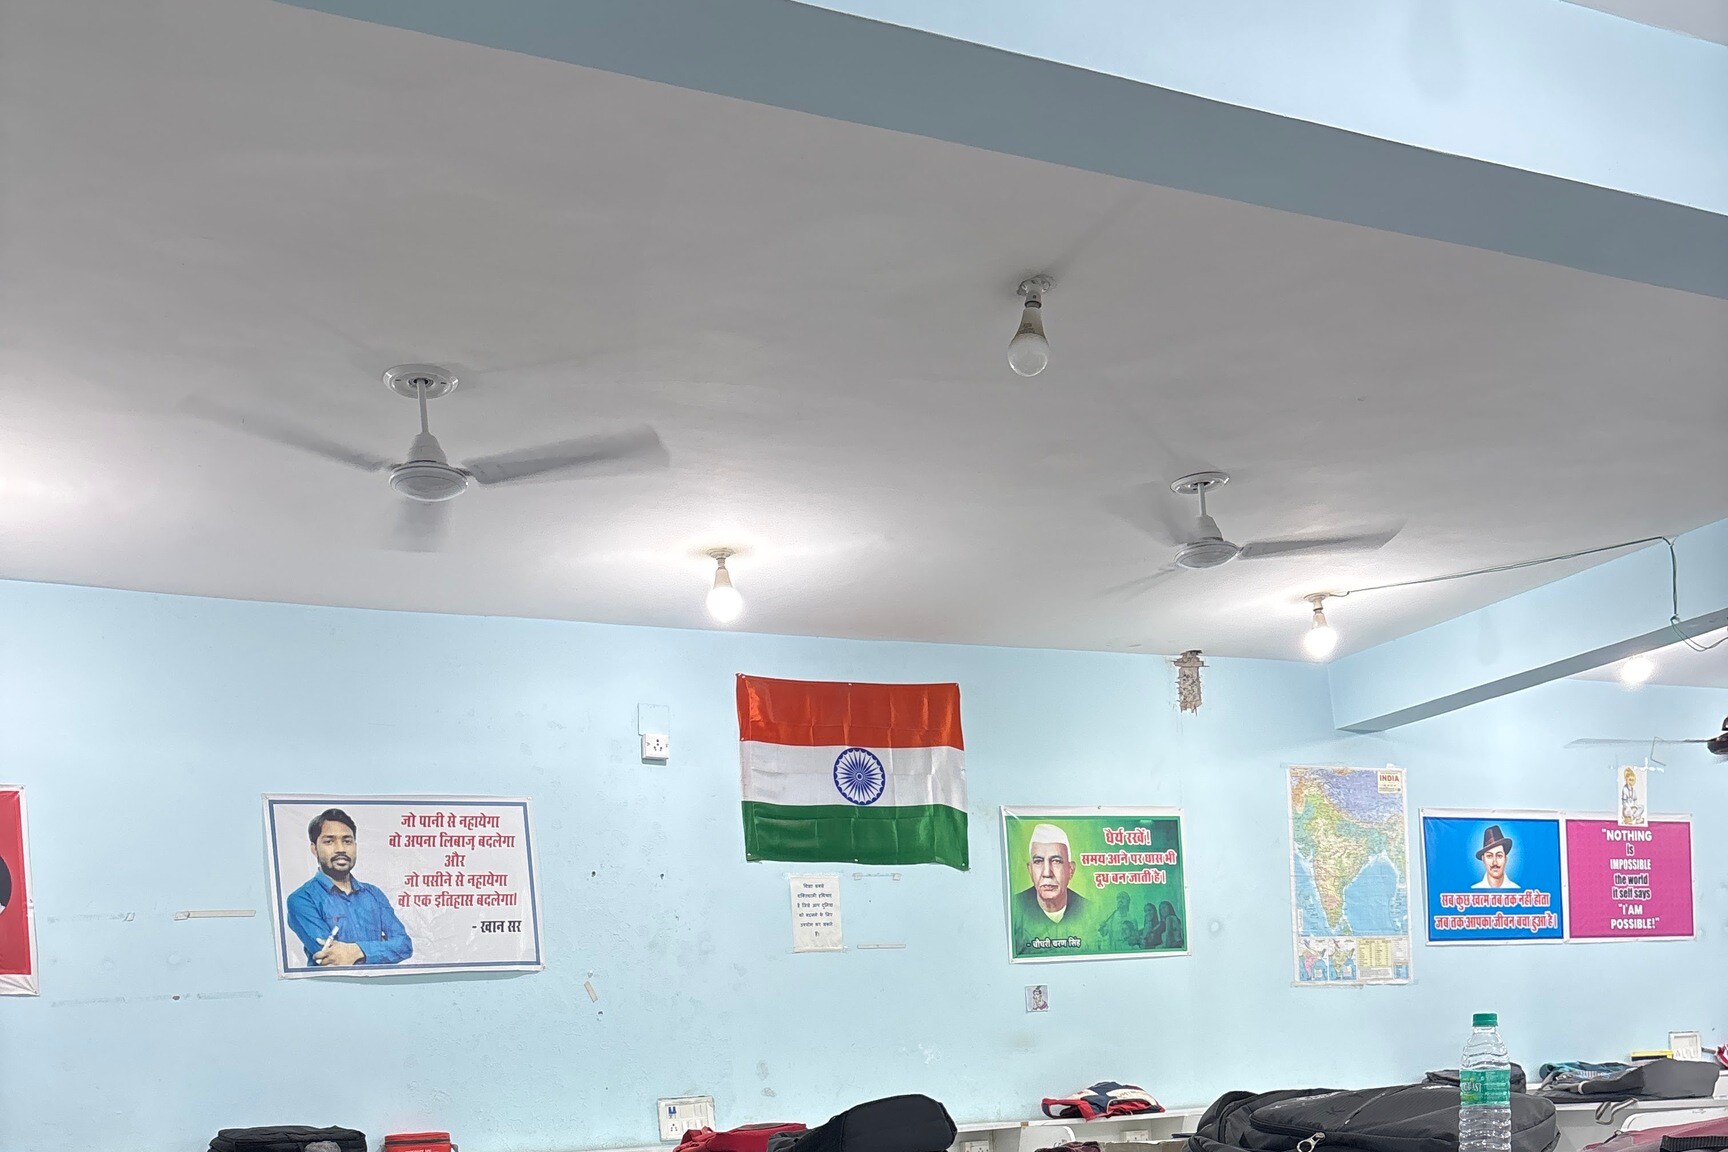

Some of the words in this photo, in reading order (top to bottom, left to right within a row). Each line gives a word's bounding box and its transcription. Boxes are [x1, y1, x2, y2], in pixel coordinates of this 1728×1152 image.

[401, 812, 416, 828] जो
[419, 812, 444, 828] पानी
[447, 812, 457, 828] से
[459, 813, 500, 830] नहायेगा
[404, 834, 437, 848] अपना
[439, 832, 476, 850] लिबाज़
[478, 833, 516, 848] बदलेगा
[1104, 828, 1123, 844] धैर्य
[444, 851, 466, 867] और
[1081, 853, 1106, 865] समय
[1108, 851, 1128, 865] आने
[1130, 853, 1143, 864] पर
[1144, 853, 1164, 864] घास
[1165, 850, 1176, 864] भी
[1610, 859, 1652, 870] IMPOSSIBLE
[404, 872, 420, 887] जो
[422, 871, 453, 887] पसीने
[455, 872, 466, 887] से
[467, 871, 508, 889] नहायेगा
[1095, 873, 1109, 887] दूध
[1112, 873, 1125, 883] बन
[1129, 870, 1152, 883] जाती
[1614, 874, 1627, 885] the
[1628, 874, 1648, 885] world
[398, 892, 411, 907] वो
[413, 894, 433, 907] एक
[435, 891, 475, 909] इतिहास
[1442, 894, 1454, 906] सब
[1456, 894, 1470, 910] कुछ
[1471, 894, 1489, 906] खत्म
[1491, 894, 1502, 905] तब
[1504, 894, 1517, 905] तक
[1518, 891, 1532, 905] नहीं
[1534, 891, 1549, 906] होता
[1612, 888, 1618, 898] it
[1619, 888, 1633, 899] self
[1634, 889, 1651, 899] says
[480, 920, 505, 933] खान
[508, 920, 522, 933] सर
[1435, 917, 1449, 928] जब
[1451, 917, 1464, 928] तक
[1465, 916, 1492, 928] आपका
[1493, 913, 1515, 928] जीवन
[1516, 916, 1530, 928] बचा
[1531, 916, 1546, 931] हुआ
[1052, 939, 1068, 948] चरण
[1068, 936, 1081, 948] सिंह
